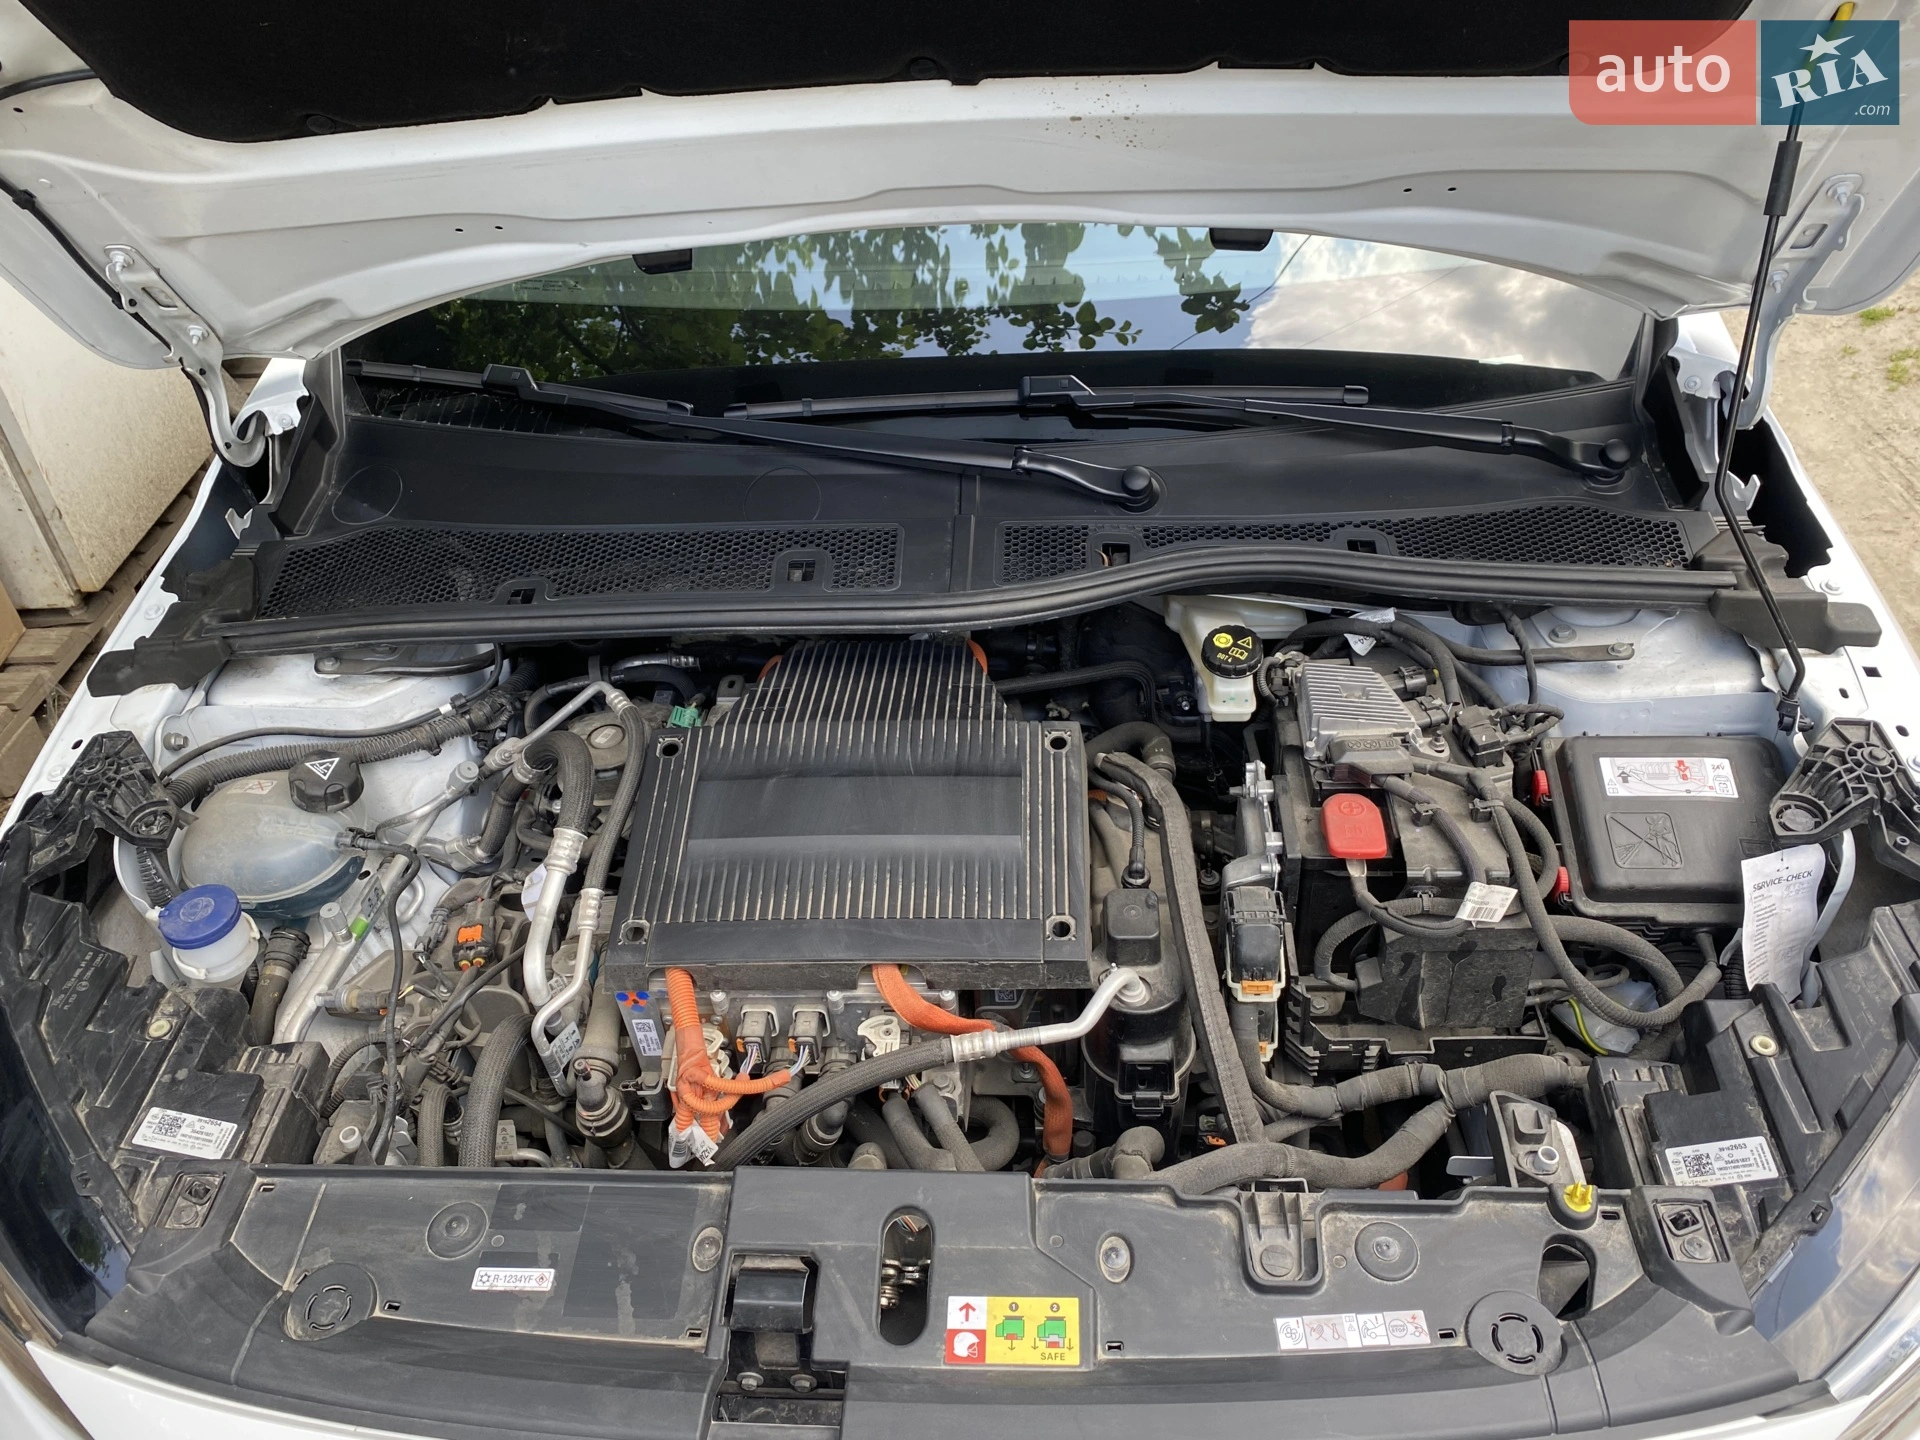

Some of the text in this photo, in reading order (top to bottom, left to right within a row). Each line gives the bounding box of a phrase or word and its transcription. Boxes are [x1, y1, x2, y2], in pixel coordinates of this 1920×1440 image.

[1752, 870, 1813, 892] SERVICE-CHECK
[492, 1274, 534, 1284] R-1234YF
[1040, 1352, 1066, 1361] SAFE
